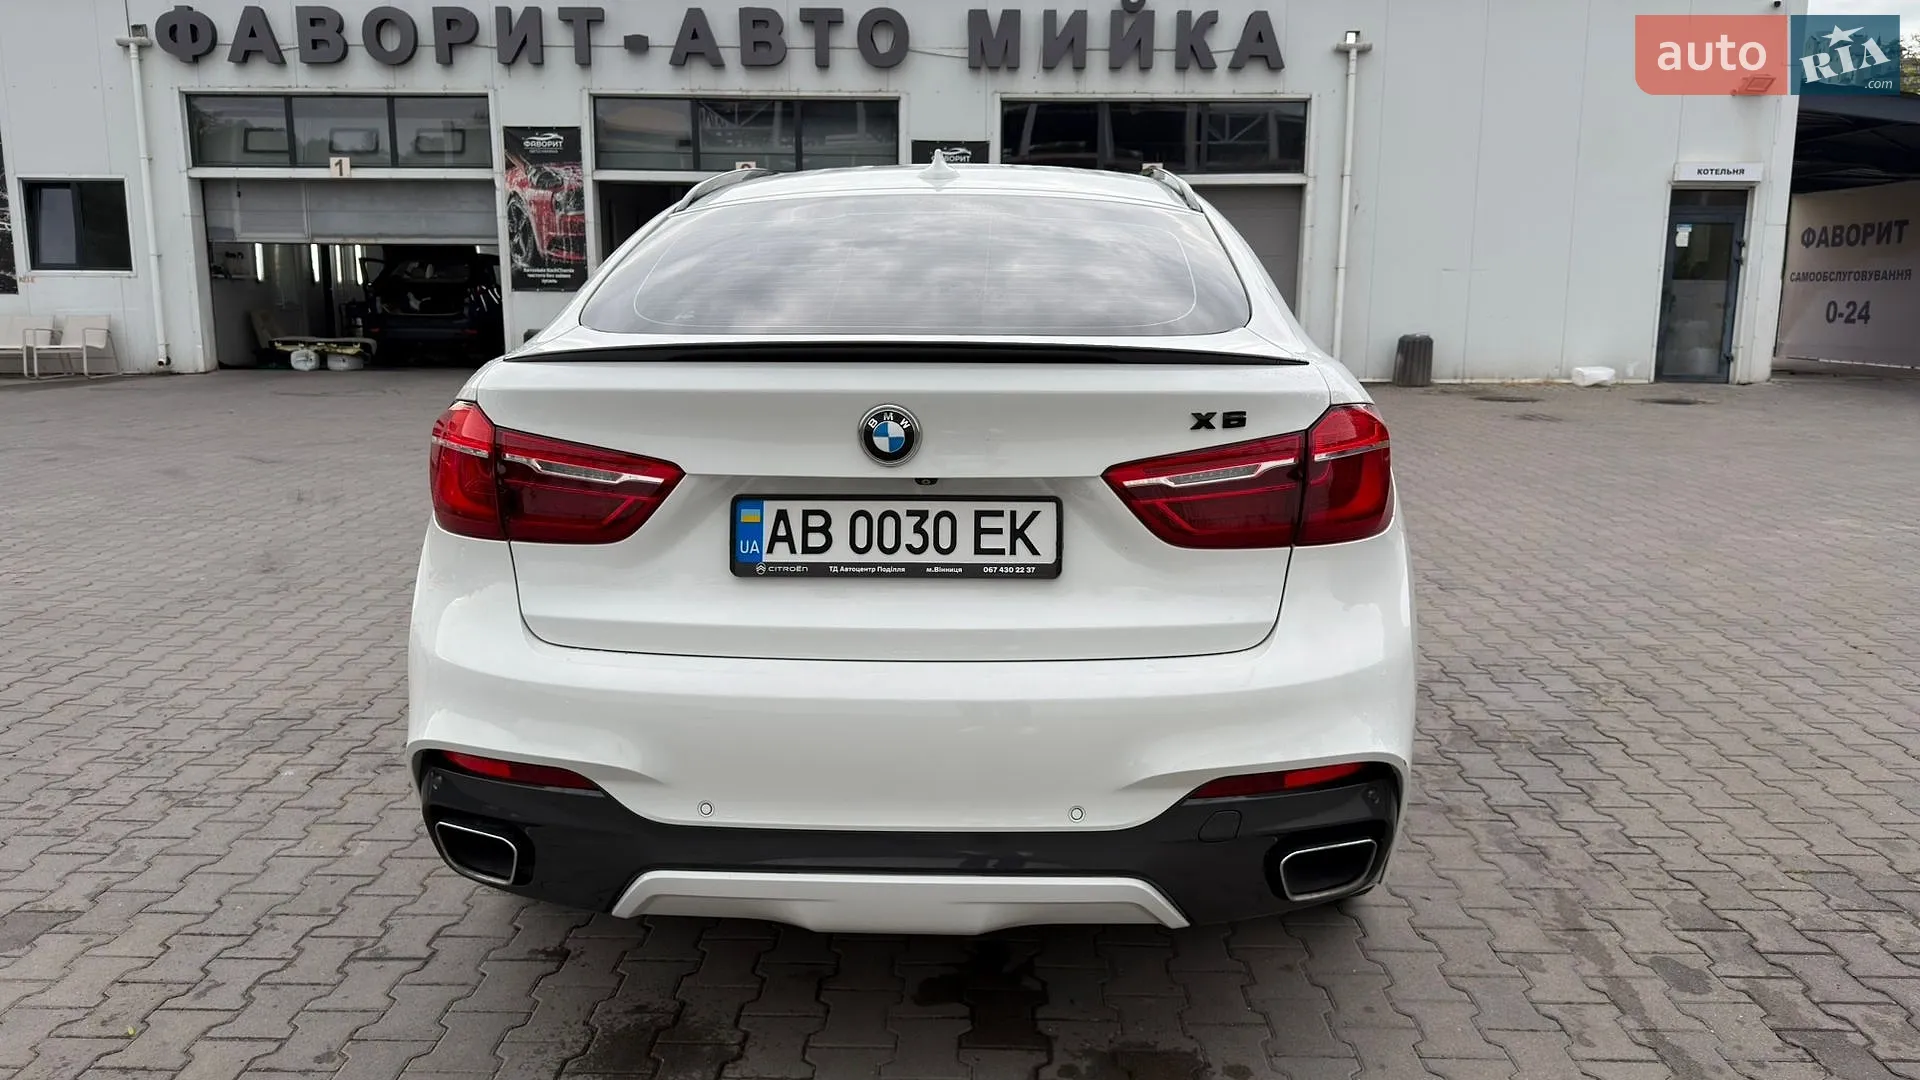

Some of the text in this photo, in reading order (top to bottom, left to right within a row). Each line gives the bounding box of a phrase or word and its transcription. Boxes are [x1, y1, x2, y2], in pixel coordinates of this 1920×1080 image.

[967, 0, 1286, 70] МИЙКА
[523, 140, 563, 148] ФАВОРИТ
[334, 158, 344, 176] 1
[1696, 168, 1745, 176] КОТЕЛЬНЯ
[1801, 219, 1910, 249] ФАВОРИТ
[1790, 268, 1912, 283] САМООБСЛУГОВУВАННЯ
[1825, 300, 1871, 325] 0-24
[867, 412, 911, 429] BMW
[1189, 410, 1247, 430] X6
[766, 508, 1042, 557] AB 0030 EK
[740, 539, 760, 554] UA
[828, 565, 1036, 574] ТД Автоцентр Поділля м.Вінниця 067 430 22 37
